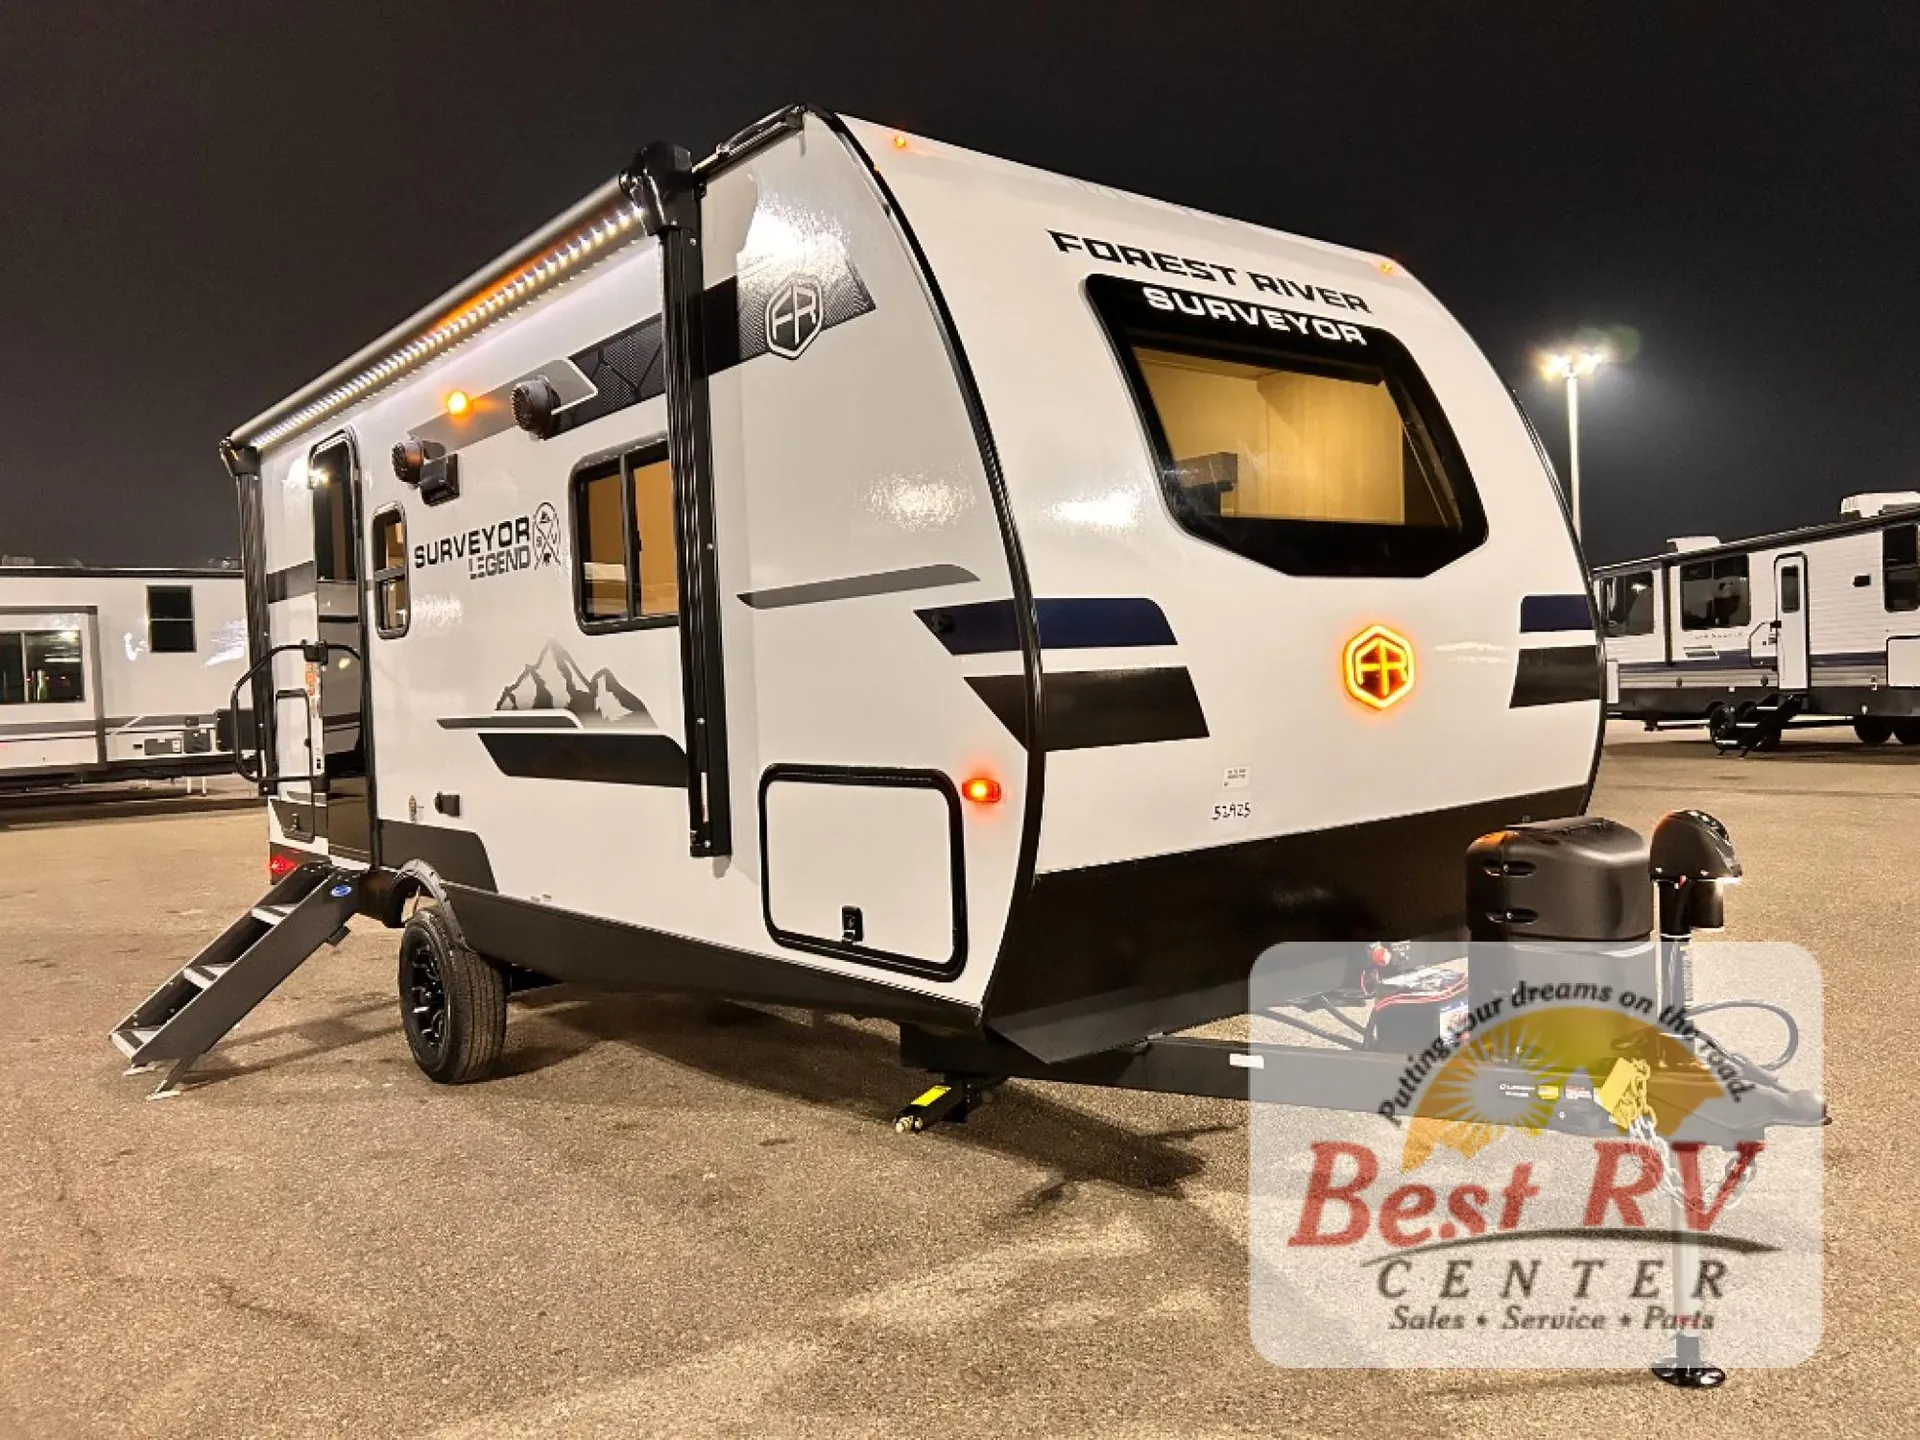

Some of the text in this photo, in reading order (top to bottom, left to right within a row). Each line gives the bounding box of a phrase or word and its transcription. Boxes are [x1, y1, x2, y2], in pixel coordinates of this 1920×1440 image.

[1045, 229, 1374, 315] FOREST RIVER
[1142, 286, 1367, 346] SURVEYOR
[414, 515, 530, 569] SURVEYOR
[468, 545, 531, 580] LEGEND
